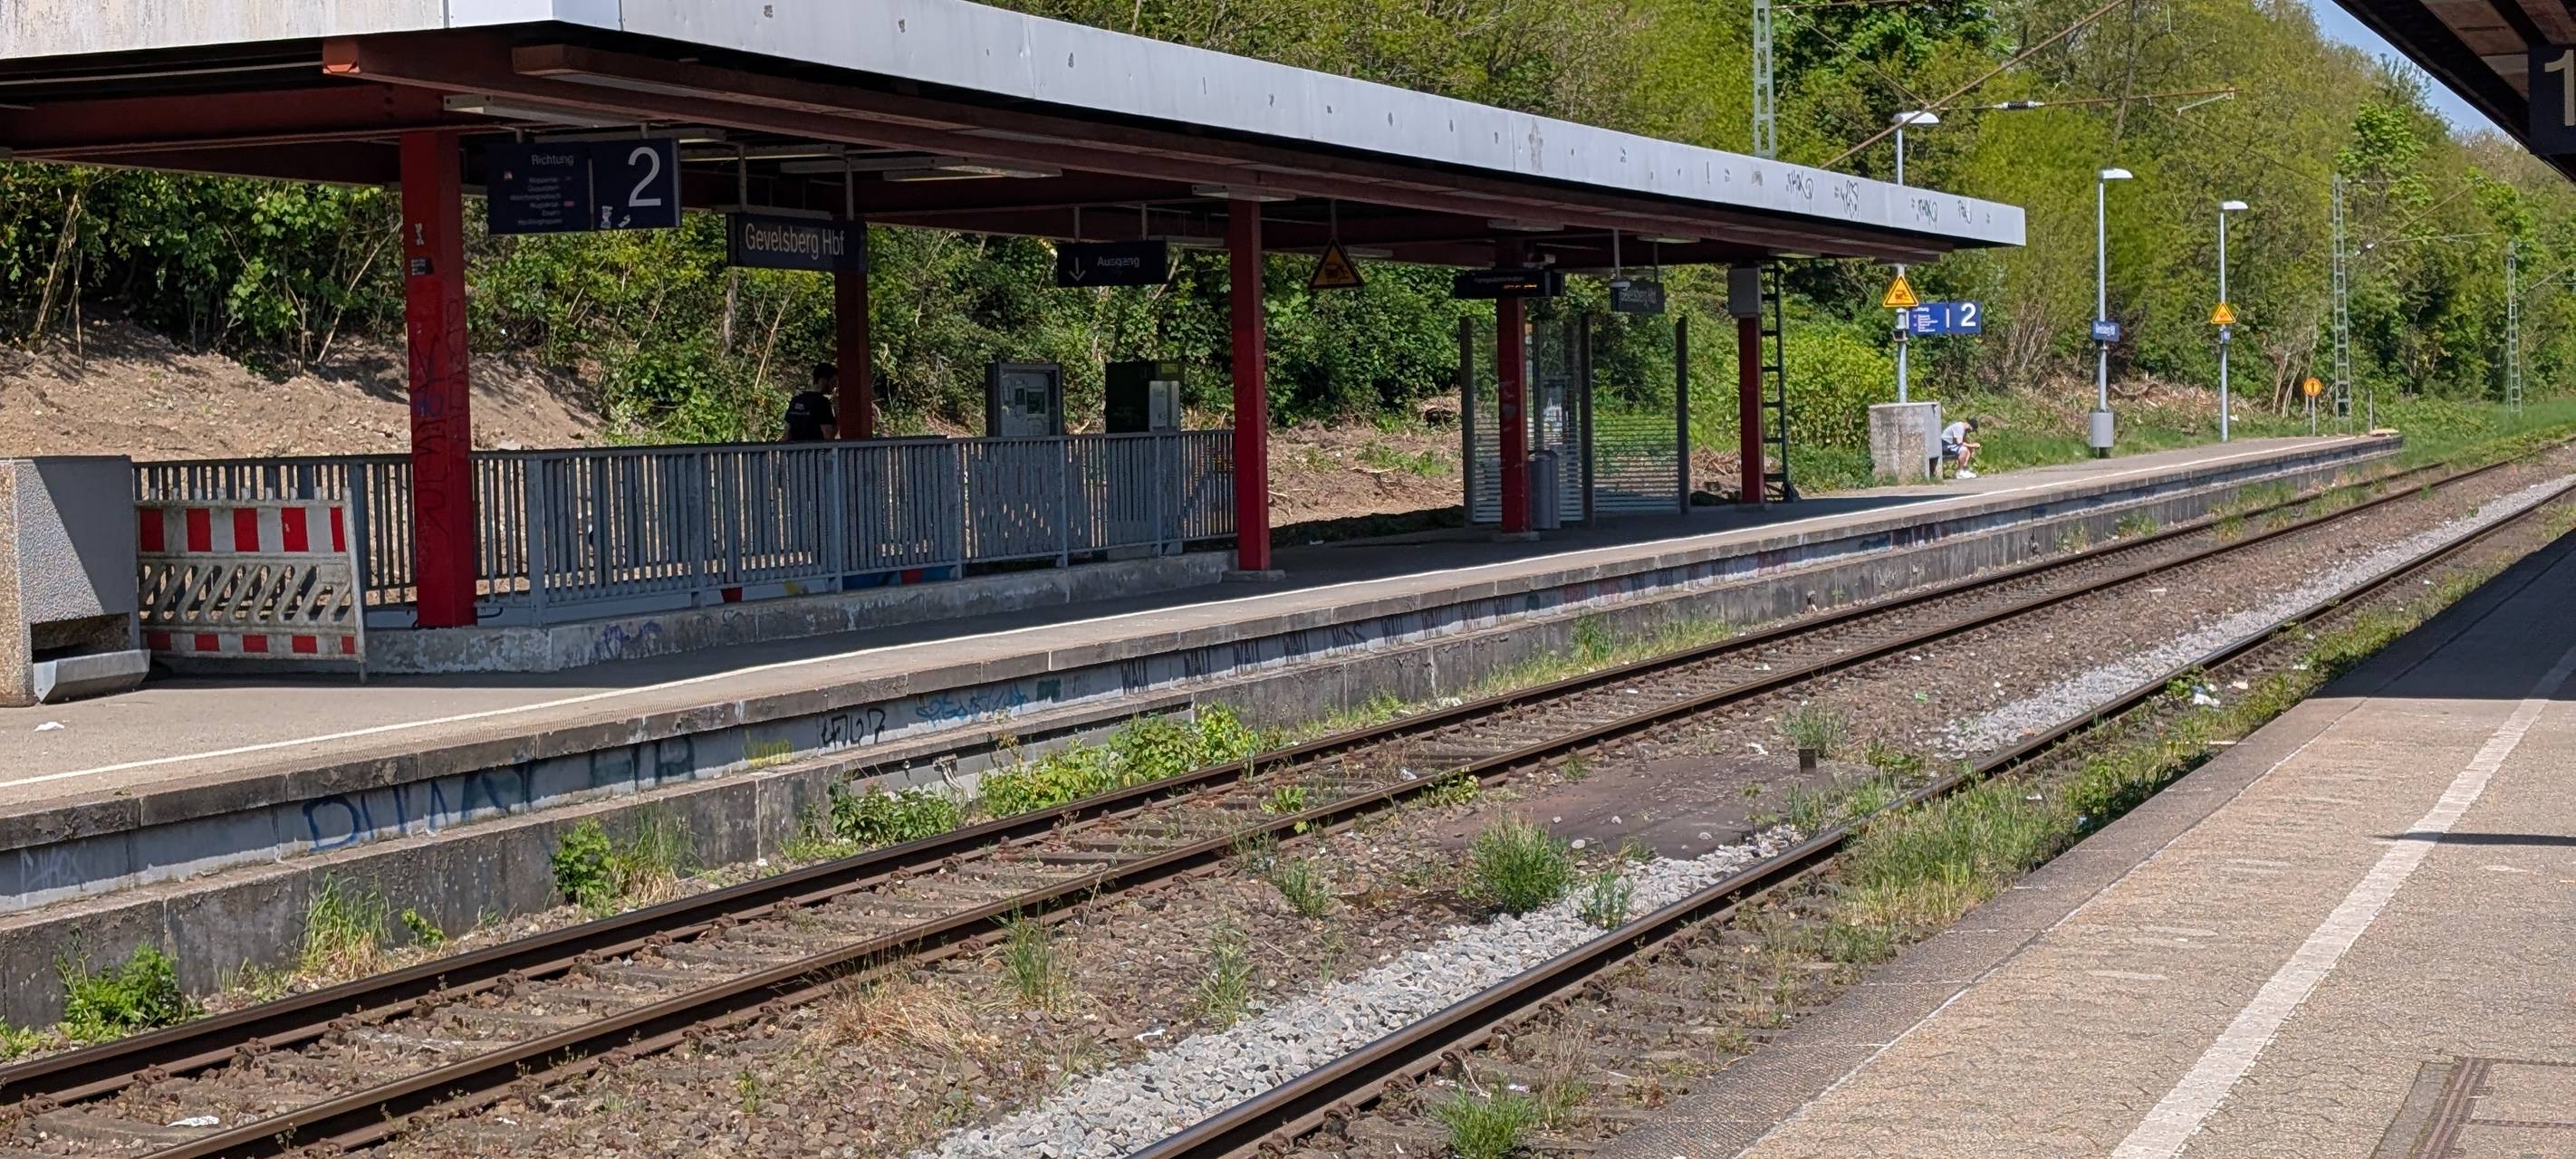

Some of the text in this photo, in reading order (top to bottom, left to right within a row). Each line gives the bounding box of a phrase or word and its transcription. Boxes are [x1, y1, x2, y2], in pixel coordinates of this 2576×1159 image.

[2544, 49, 2575, 126] 1
[531, 153, 574, 167] Richtung
[627, 146, 661, 207] 2
[745, 223, 844, 260] Gevelsberg Hbf
[1097, 256, 1139, 267] Ausgang
[1961, 302, 1976, 327] 2
